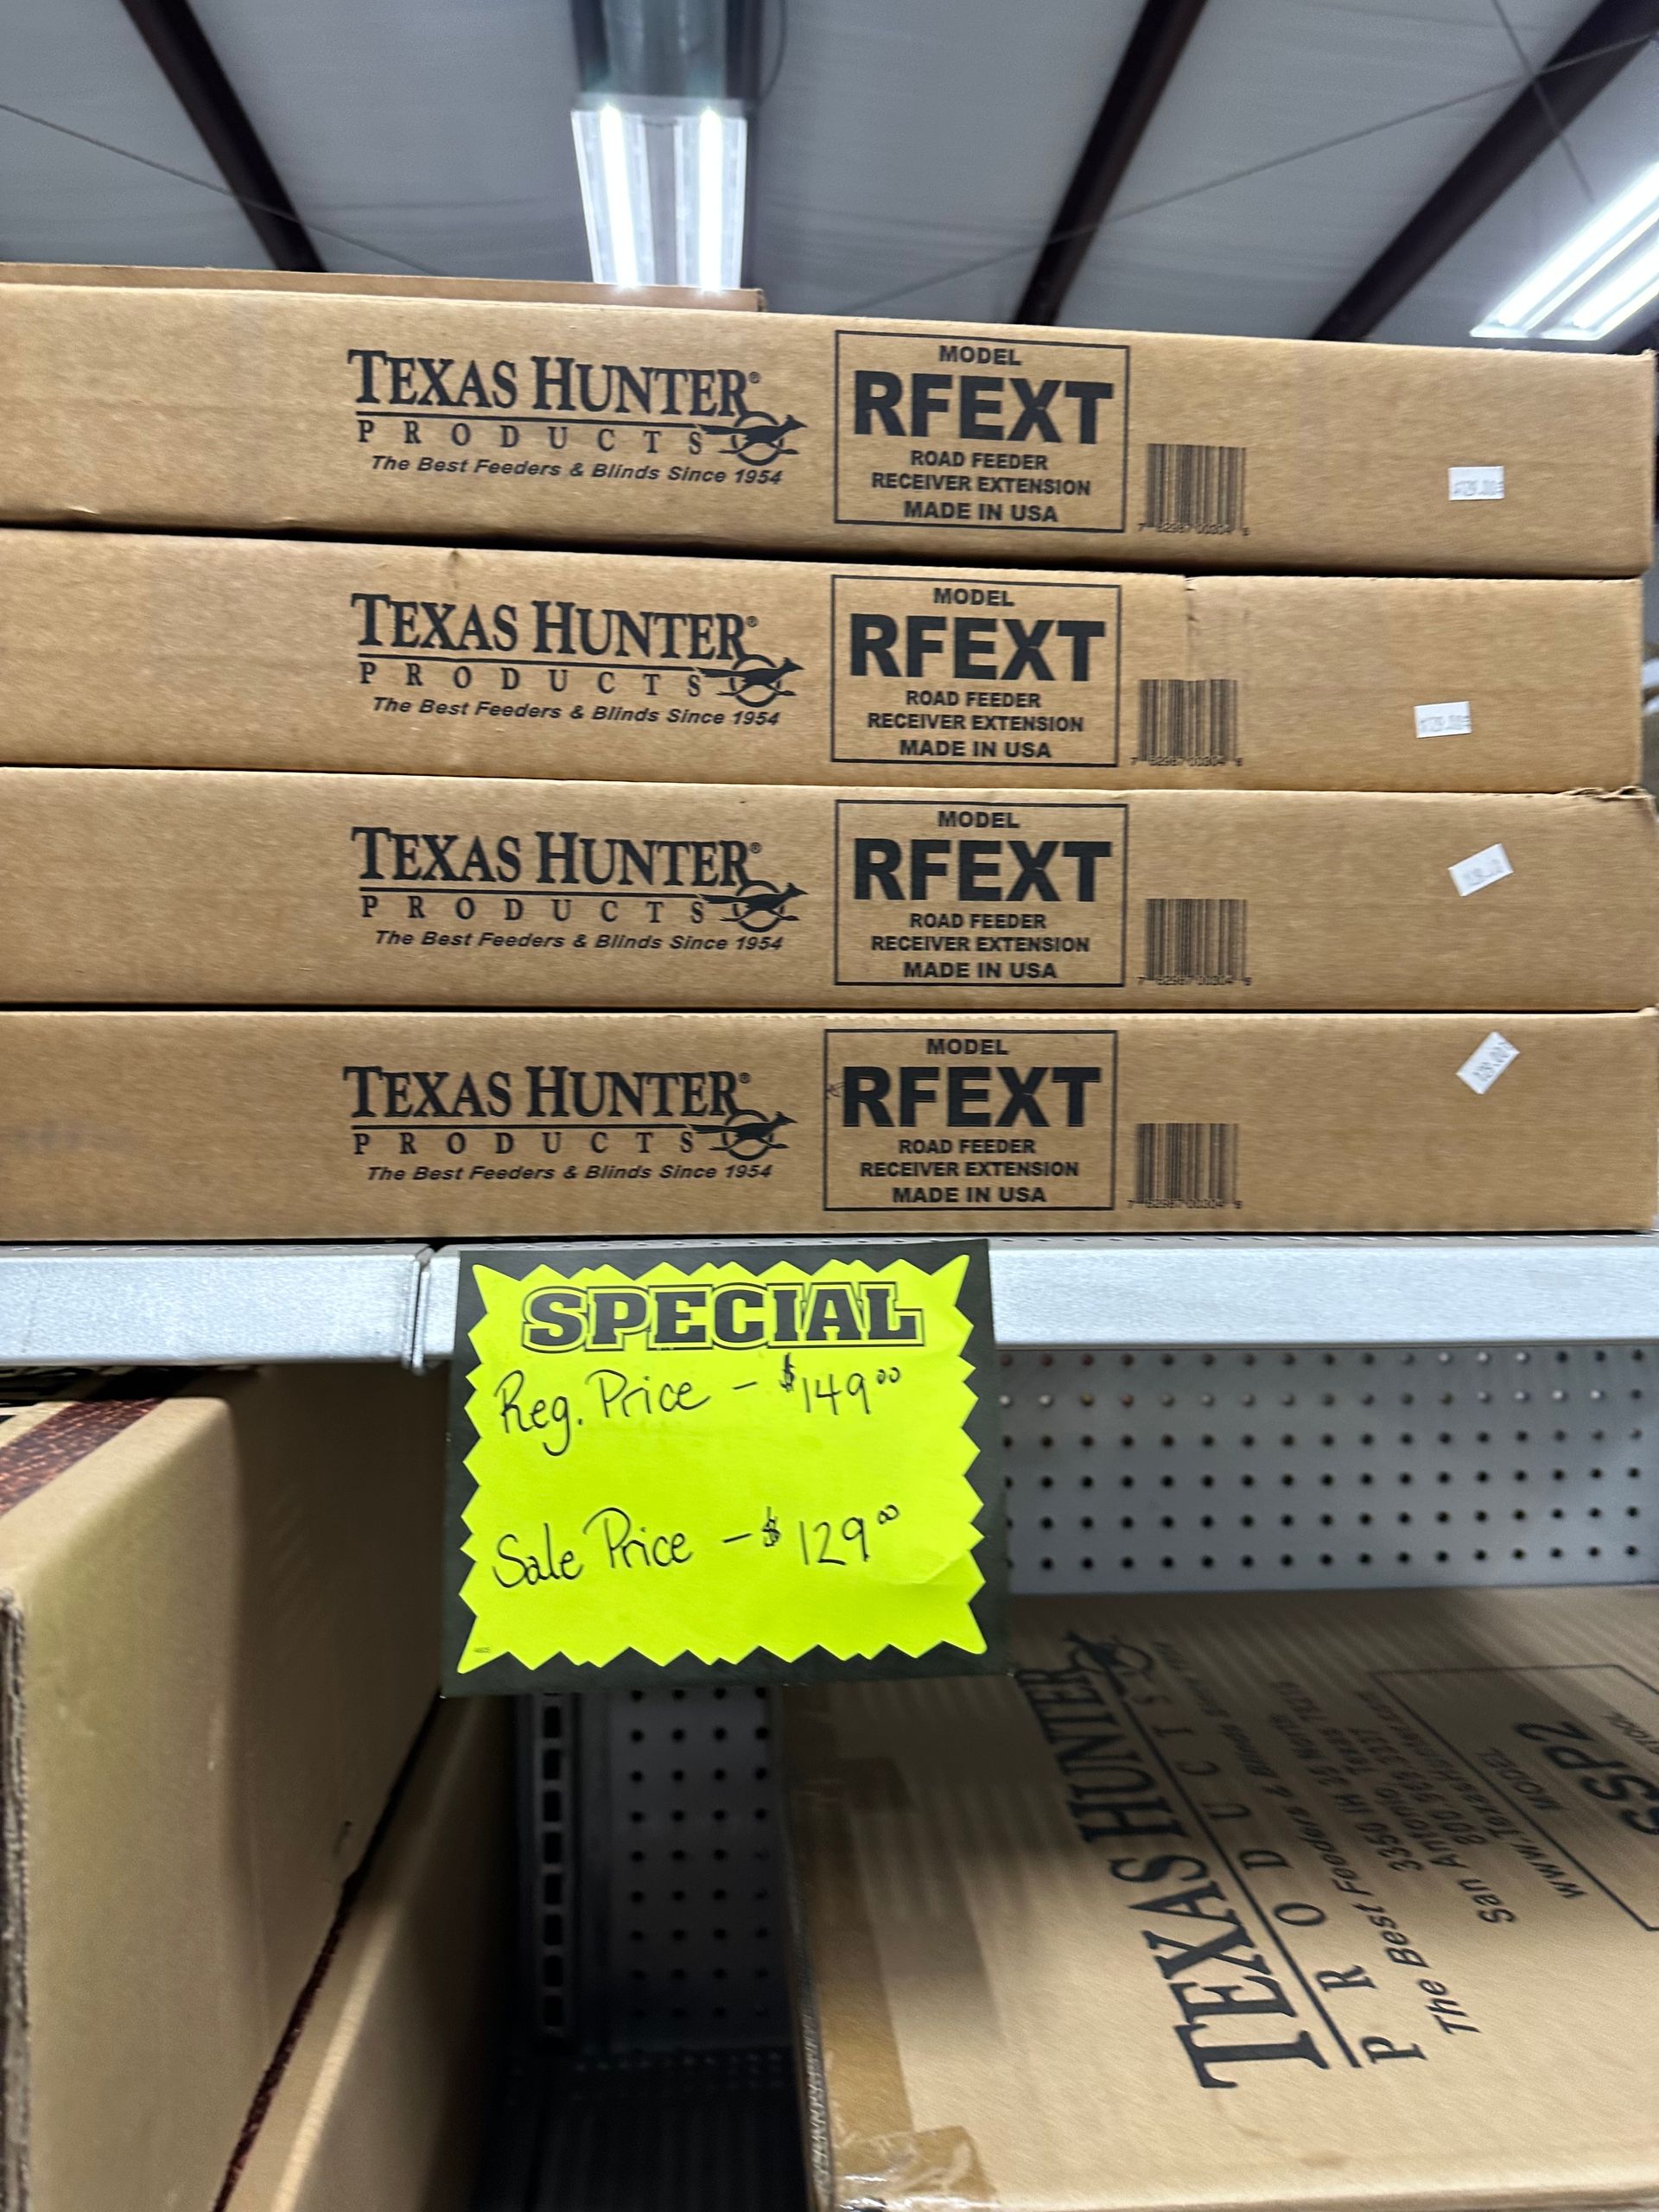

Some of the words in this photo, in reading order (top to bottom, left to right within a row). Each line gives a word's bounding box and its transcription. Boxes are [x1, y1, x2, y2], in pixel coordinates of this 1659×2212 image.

[938, 345, 1023, 366] MODEL
[346, 348, 518, 410] TEXAS
[853, 370, 1115, 445] RFEXT
[358, 420, 702, 455] PRODUCTS
[372, 454, 410, 471] The
[416, 456, 469, 474] Best
[473, 458, 563, 477] Feeders
[569, 461, 584, 478] &
[590, 462, 661, 480] Blinds
[667, 465, 728, 484] Since
[734, 468, 783, 485] 1954
[910, 449, 966, 467] ROAD
[971, 452, 1049, 471] FEEDER
[871, 471, 972, 492] RECEIVER
[976, 475, 1091, 496] EXTENSION
[904, 499, 971, 520] MADE
[978, 503, 1003, 521] IN
[1010, 504, 1059, 523] USA
[932, 587, 1015, 607] MODEL
[350, 592, 518, 652] TEXAS
[849, 613, 1106, 683] RFEXT
[359, 662, 701, 697] PRODUCTS
[373, 696, 412, 713] The
[418, 698, 470, 715] Best
[474, 701, 563, 719] Feeders
[569, 704, 585, 720] &
[591, 705, 660, 722] Blinds
[665, 708, 726, 725] Since
[733, 710, 781, 726] 1954
[906, 690, 960, 707] ROAD
[965, 691, 1042, 709] FEEDER
[867, 712, 967, 730] RECEIVER
[970, 715, 1084, 733] EXTENSION
[899, 739, 966, 757] MADE
[972, 741, 997, 758] IN
[1004, 741, 1052, 759] USA
[938, 810, 1020, 830] MODEL
[350, 826, 522, 883] TEXAS
[853, 837, 1113, 903] RFEXT
[362, 895, 704, 924] PRODUCTS
[909, 912, 965, 929] ROAD
[969, 913, 1047, 930] FEEDER
[376, 930, 415, 945] The
[420, 931, 474, 947] Best
[477, 931, 566, 948] Feeders
[572, 933, 588, 949] &
[594, 933, 663, 950] Blinds
[669, 934, 728, 950] Since
[735, 936, 784, 951] 1954
[870, 935, 971, 952] RECEIVER
[976, 936, 1090, 953] EXTENSION
[903, 961, 970, 979] MADE
[977, 962, 1002, 979] IN
[1009, 962, 1058, 979] USA
[926, 1038, 1010, 1056] MODEL
[342, 1065, 512, 1119] TEXAS
[841, 1065, 1103, 1128] RFEXT
[353, 1132, 694, 1154] PRODUCTS
[899, 1139, 953, 1154] ROAD
[958, 1138, 1036, 1154] FEEDER
[367, 1166, 406, 1181] The
[411, 1166, 464, 1181] Best
[468, 1165, 556, 1180] Feeders
[563, 1165, 578, 1179] &
[583, 1165, 652, 1179] Blinds
[658, 1164, 717, 1179] Since
[725, 1164, 773, 1179] 1954
[860, 1161, 960, 1178] RECEIVER
[964, 1160, 1079, 1177] EXTENSION
[892, 1186, 959, 1204] MADE
[966, 1186, 991, 1203] IN
[998, 1186, 1047, 1203] USA
[522, 1281, 925, 1353] SPECIAL
[585, 1369, 711, 1419] Price
[493, 1523, 583, 1588] Sale
[583, 1507, 694, 1569] Price
[1457, 1878, 1518, 1924] San
[1352, 1904, 1430, 1968] Best
[1109, 1855, 1331, 2089] TEXAS
[1417, 1979, 1481, 2035] The
